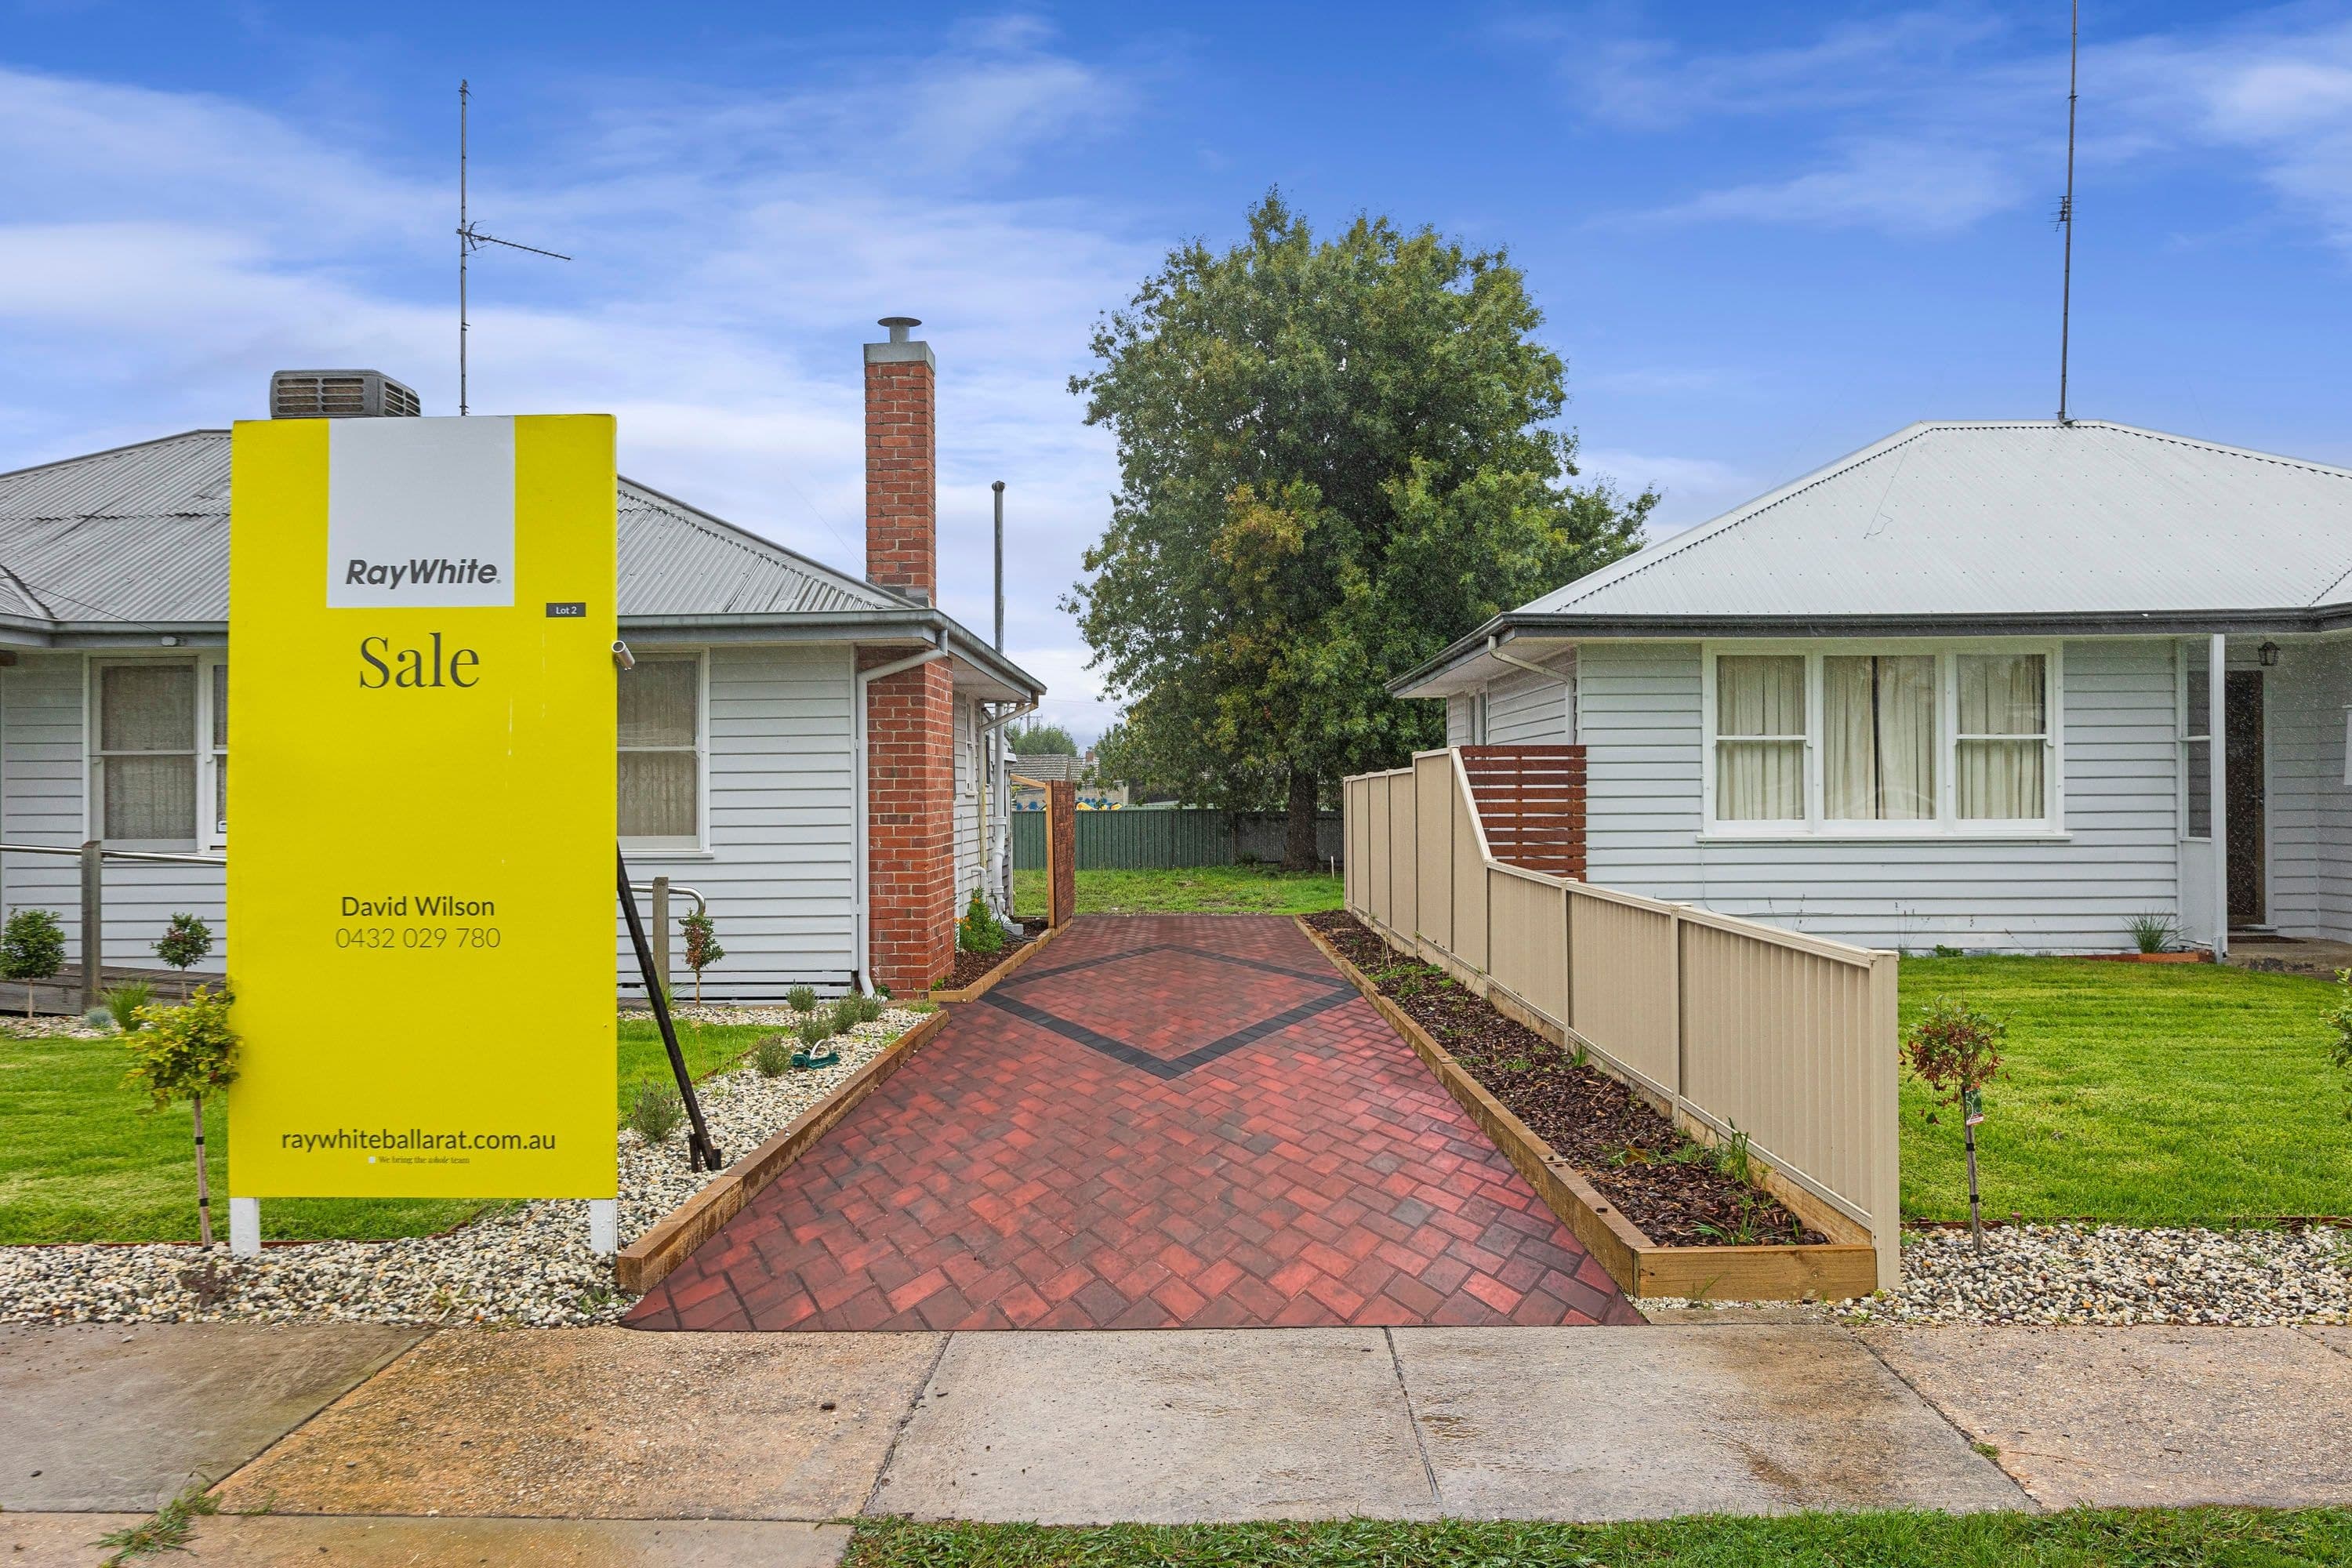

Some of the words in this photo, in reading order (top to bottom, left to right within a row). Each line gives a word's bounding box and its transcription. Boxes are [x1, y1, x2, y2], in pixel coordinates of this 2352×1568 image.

[556, 606, 570, 615] Lot
[571, 606, 578, 615] 2
[360, 632, 479, 689] Sale
[342, 895, 407, 916] David
[414, 895, 495, 916] Wilson
[336, 927, 395, 949] 0432
[403, 927, 447, 949] 029
[456, 927, 501, 949] 780
[281, 1128, 556, 1153] raywhiteballarat.com.au
[392, 1156, 413, 1165] bring
